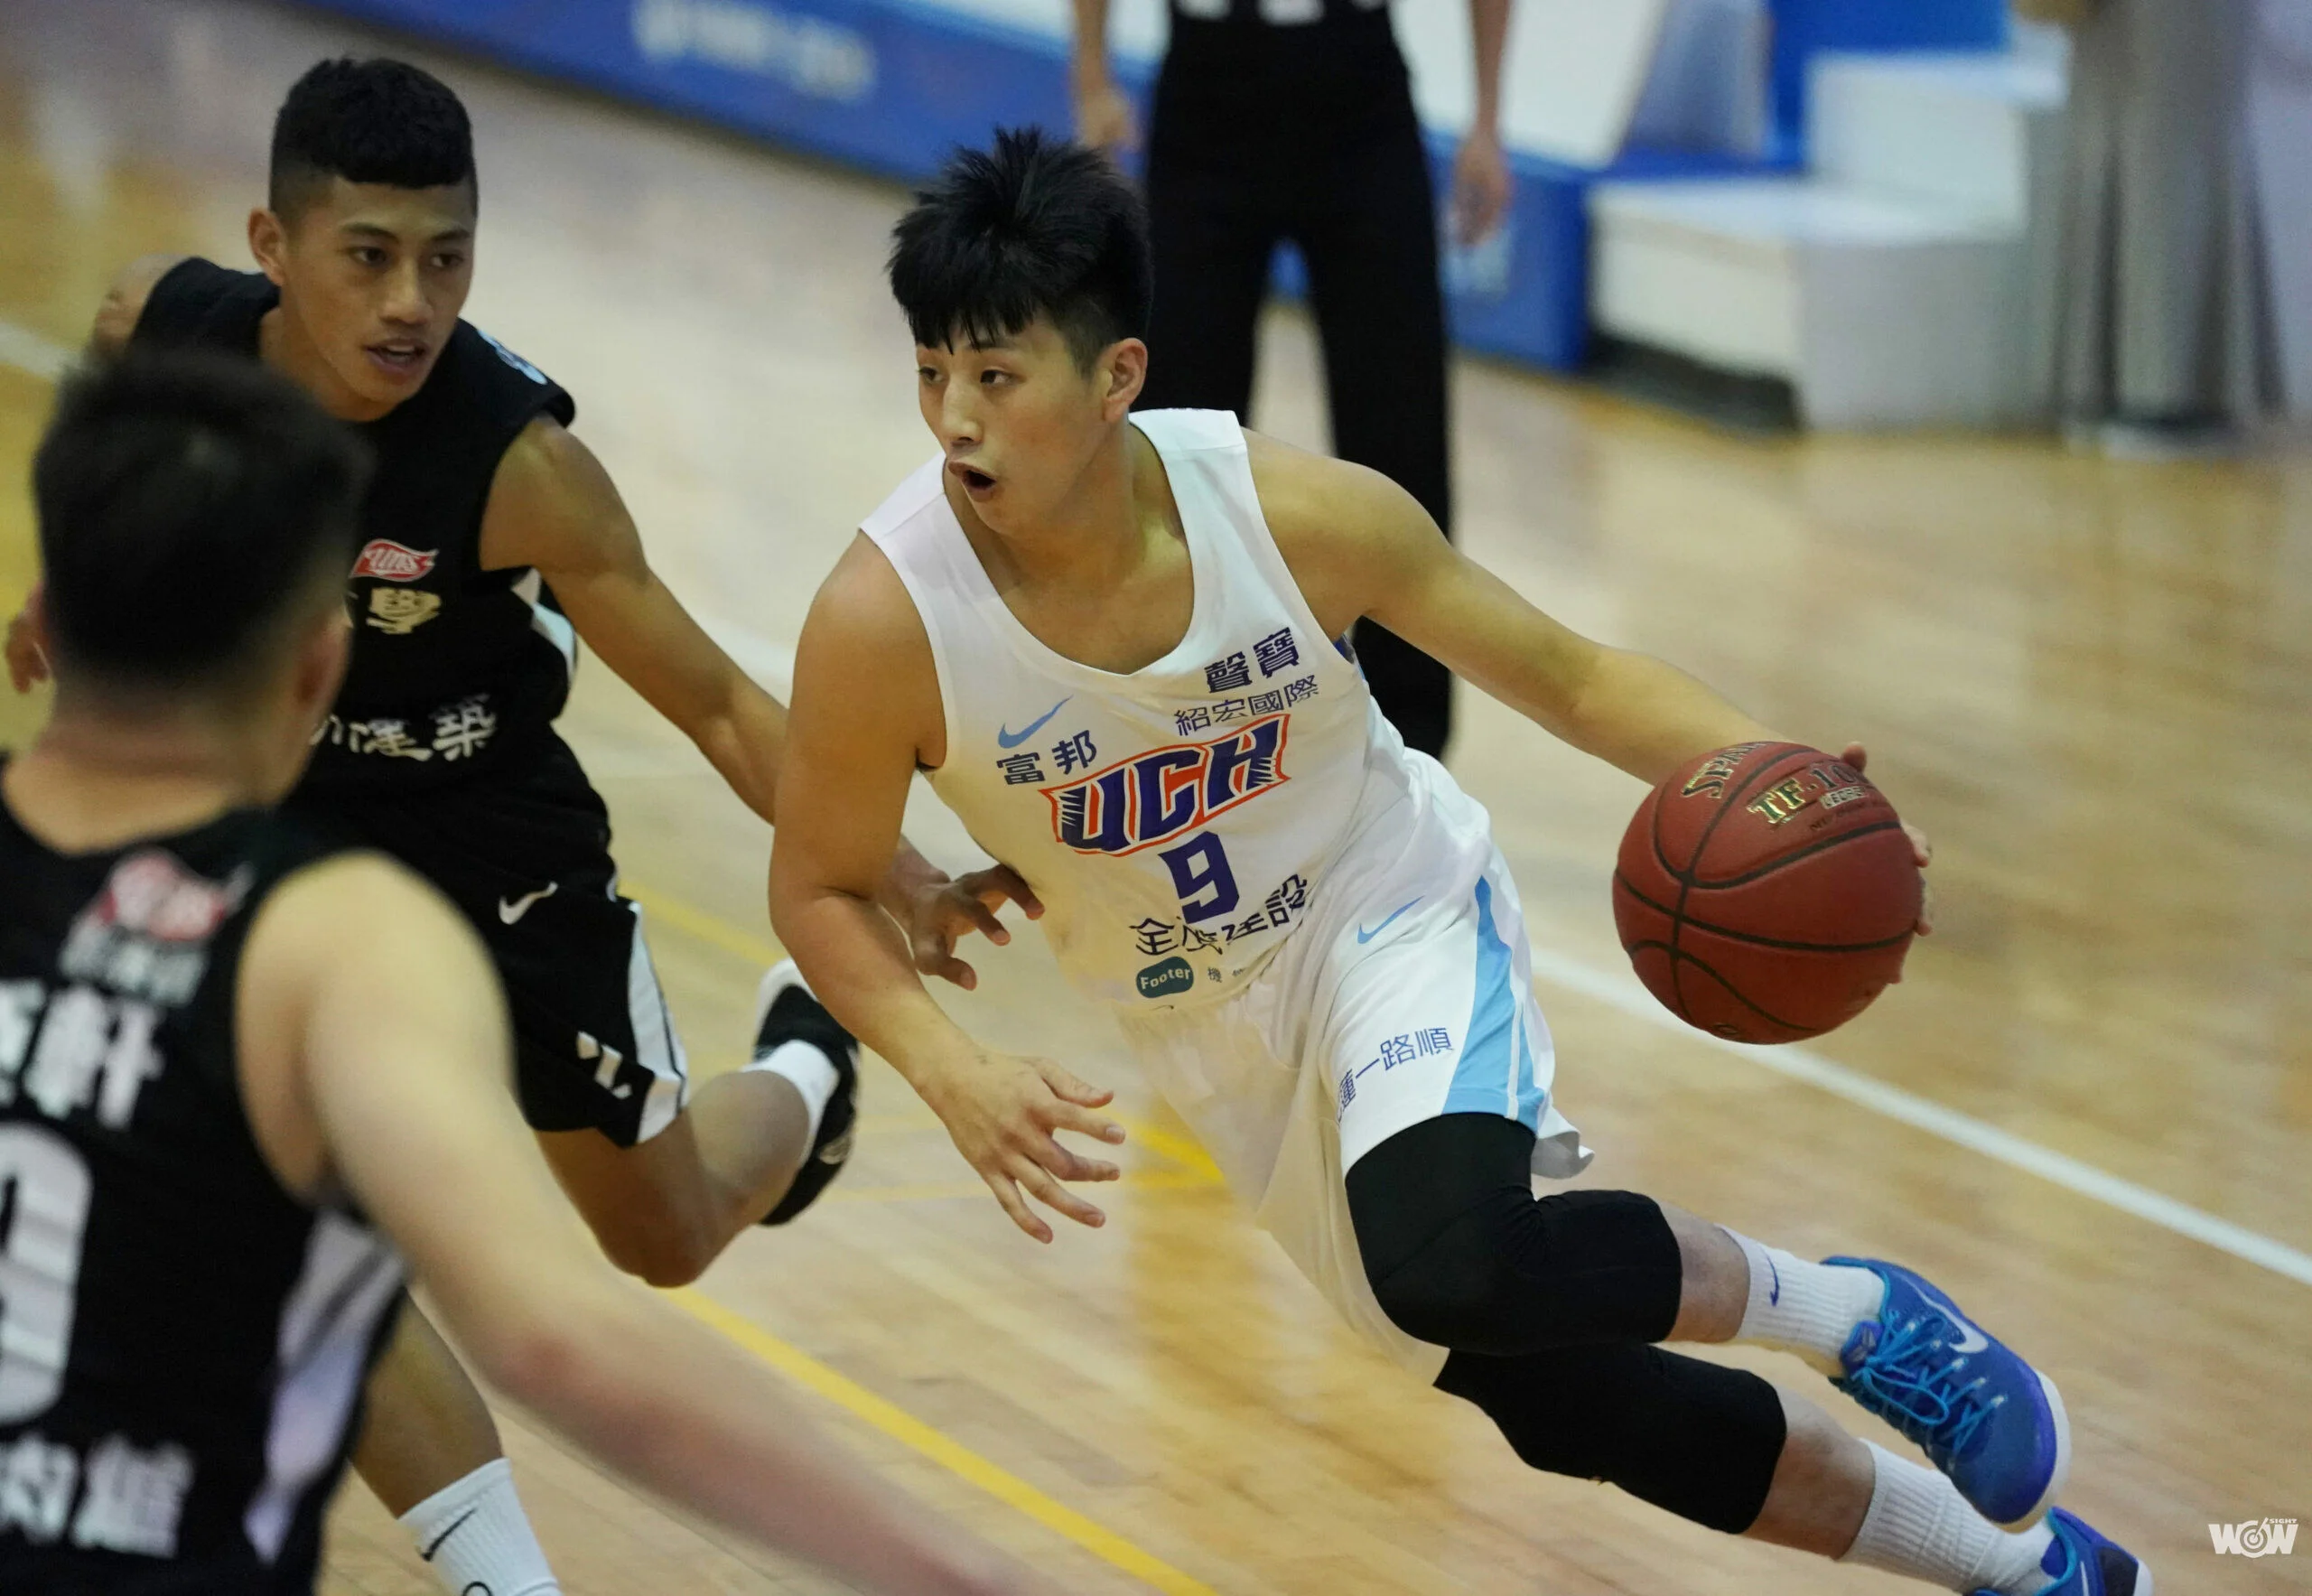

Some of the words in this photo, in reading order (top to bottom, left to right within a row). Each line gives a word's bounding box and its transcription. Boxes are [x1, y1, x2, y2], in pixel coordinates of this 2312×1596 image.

[1204, 627, 1300, 694] 聲寶
[1173, 674, 1319, 736] 紹宏國際
[996, 729, 1097, 786] 富邦
[1057, 718, 1283, 853] UCH
[1157, 830, 1241, 925] 9
[1139, 966, 1192, 990] Footer
